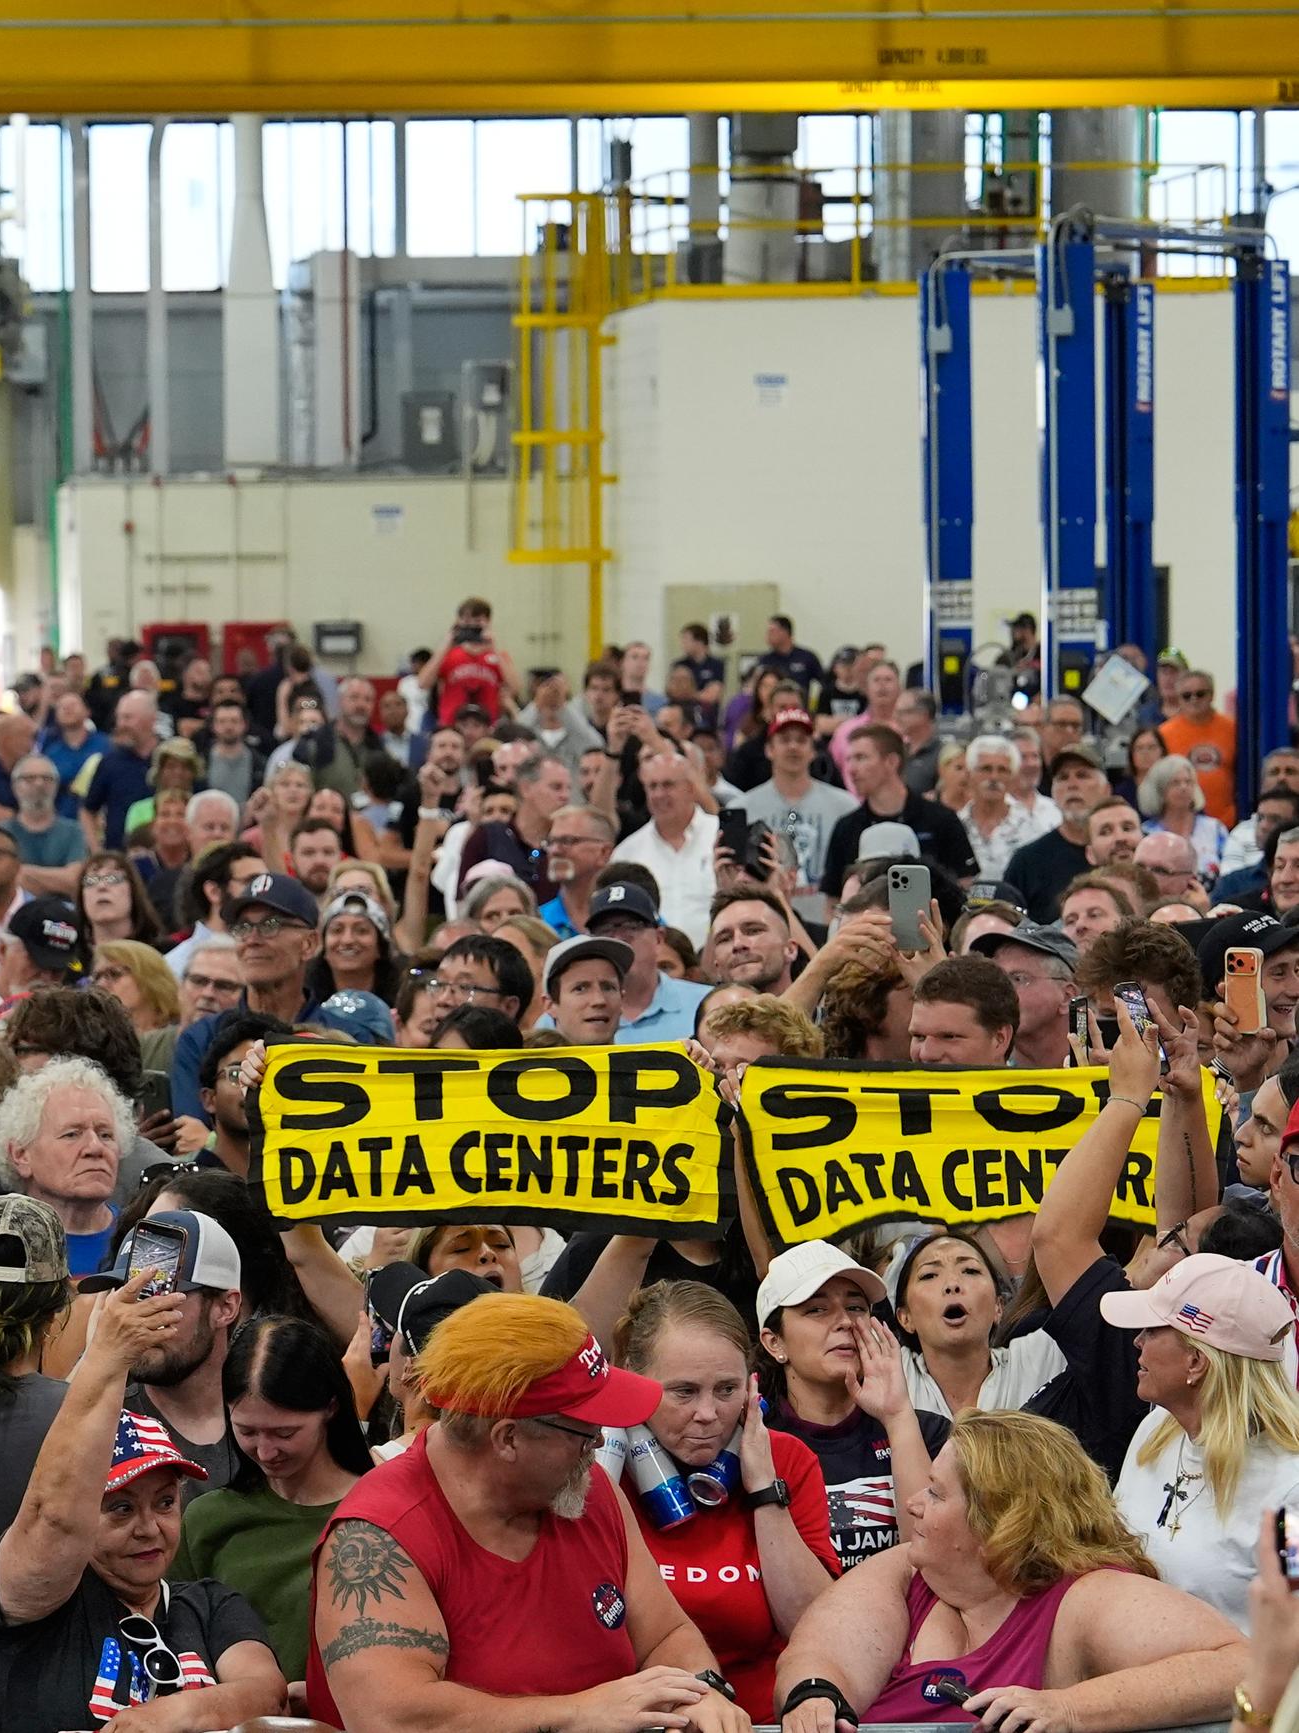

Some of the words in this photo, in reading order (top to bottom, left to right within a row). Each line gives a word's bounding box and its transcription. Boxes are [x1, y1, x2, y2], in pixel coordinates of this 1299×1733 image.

[1137, 285, 1151, 325] LIFT
[1270, 261, 1287, 304] LIFT
[1137, 327, 1151, 402] ROTARY
[1270, 306, 1287, 389] ROTARY
[274, 1050, 701, 1130] STOP
[760, 1080, 1161, 1150] STO
[279, 1134, 435, 1205] DATA
[450, 1130, 695, 1206] CENTERS
[776, 1150, 931, 1227] DATA
[847, 1529, 899, 1551] JAM
